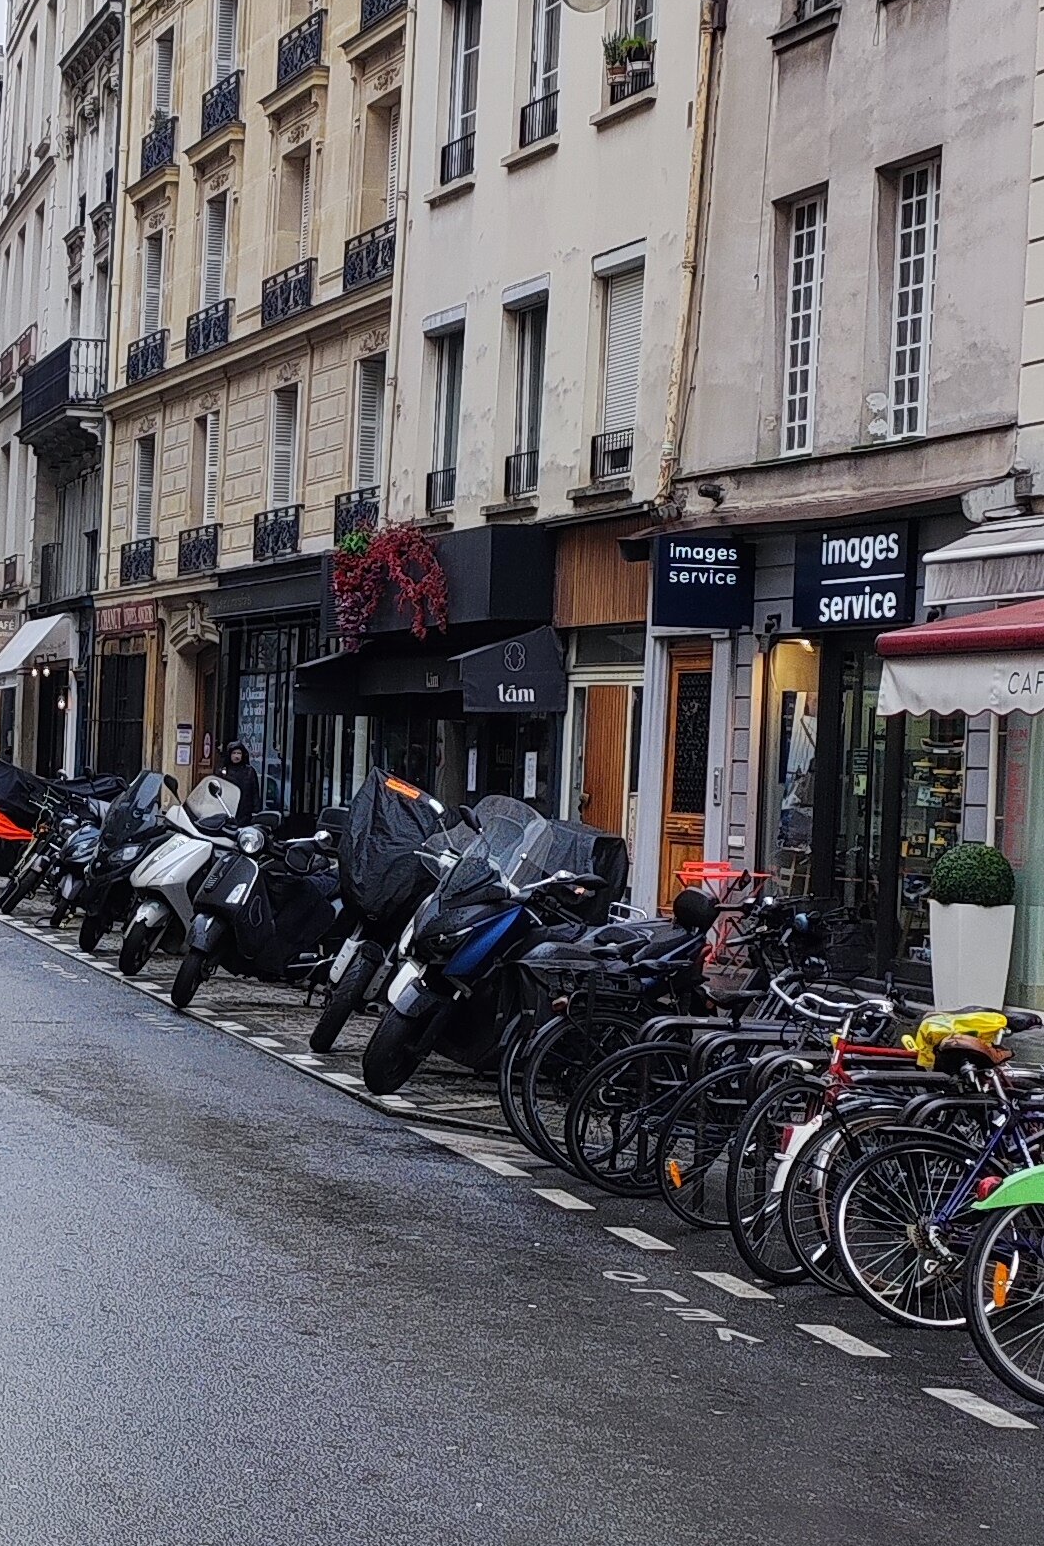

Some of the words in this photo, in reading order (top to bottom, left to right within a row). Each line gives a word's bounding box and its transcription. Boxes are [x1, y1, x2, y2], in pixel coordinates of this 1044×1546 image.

[670, 542, 738, 563] images
[821, 531, 899, 569] images
[669, 570, 737, 585] service
[818, 585, 897, 623] service
